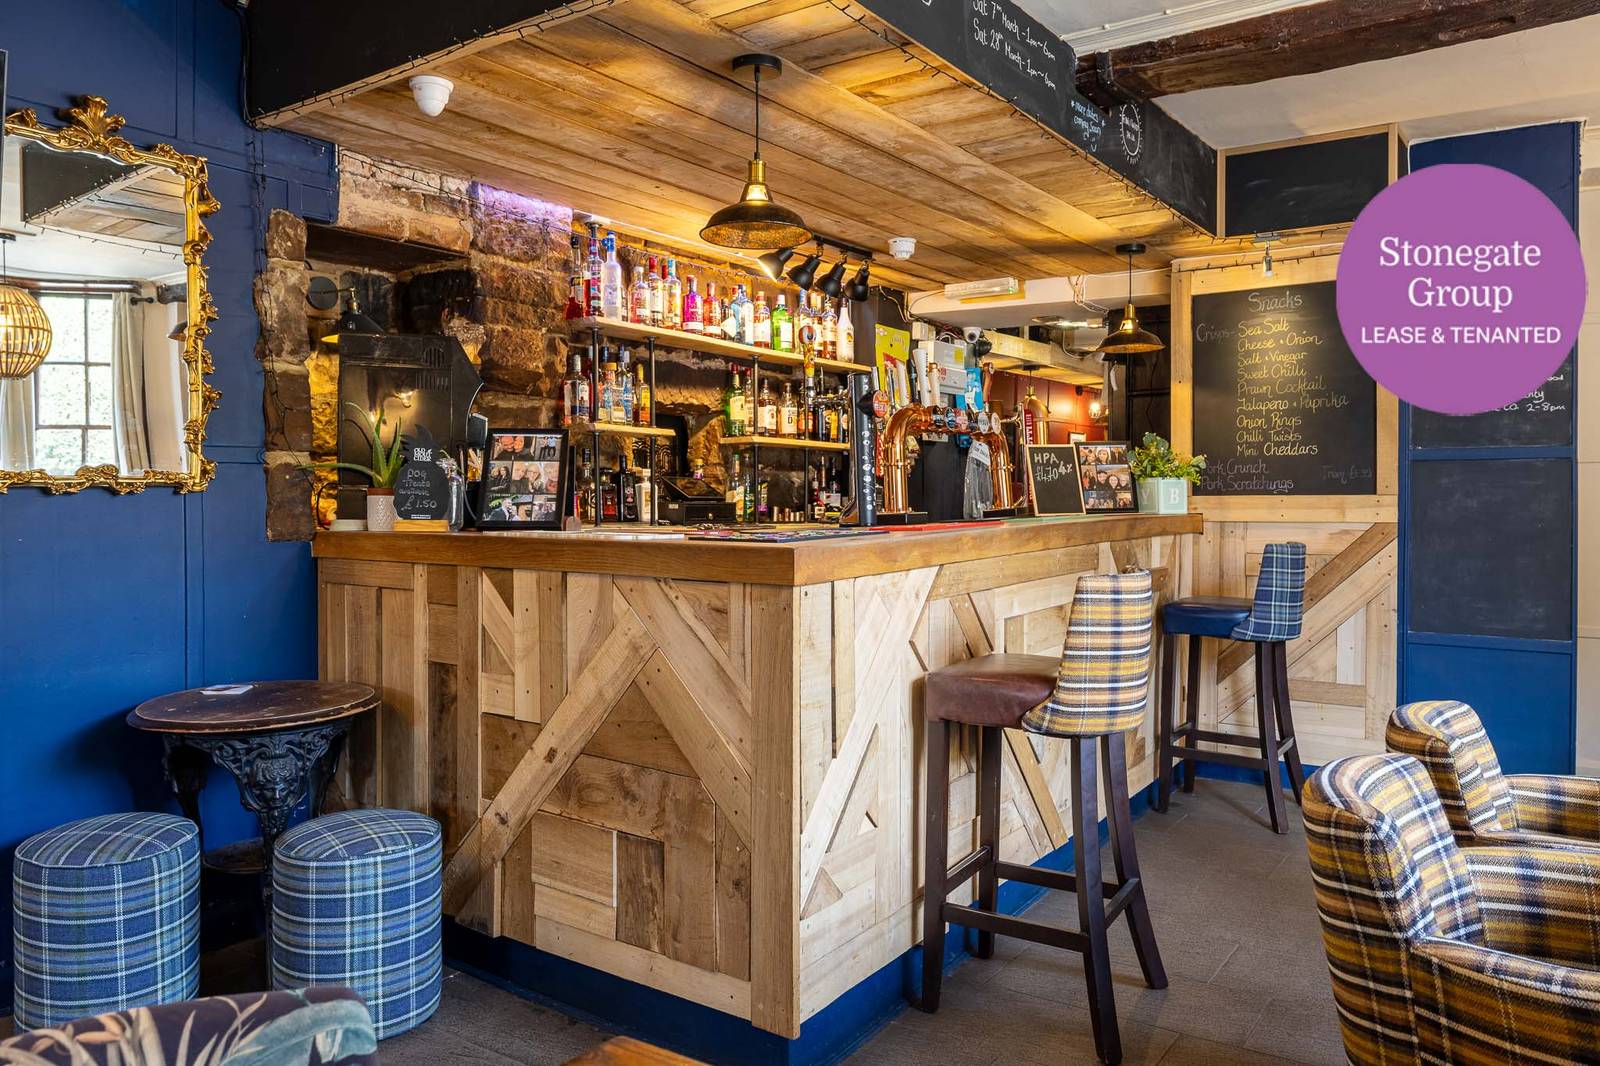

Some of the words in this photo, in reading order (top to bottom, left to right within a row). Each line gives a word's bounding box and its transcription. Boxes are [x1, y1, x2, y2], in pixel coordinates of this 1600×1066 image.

[973, 18, 988, 46] Sat
[1248, 290, 1303, 312] Snacks
[1238, 320, 1262, 338] Sea
[1263, 317, 1289, 335] Salt
[1237, 338, 1276, 352] Cheese
[1286, 331, 1323, 346] Onion
[1237, 352, 1262, 368] Salt
[1269, 351, 1308, 367] Vinegar
[1237, 365, 1269, 381] Sweet
[1271, 363, 1307, 378] Chilli
[1237, 382, 1273, 398] Prawn
[1276, 375, 1326, 396] Cocktail
[1300, 390, 1349, 413] Paprika
[1236, 414, 1267, 429] Onion
[1271, 411, 1302, 431] Rings
[1236, 430, 1264, 442] Chilli
[1269, 429, 1302, 442] Twists
[1034, 452, 1059, 465] HPA
[1237, 443, 1260, 457] Mini
[1263, 442, 1318, 456] Cheddars
[1227, 458, 1269, 474] Crunch
[1200, 475, 1226, 492] Pork
[400, 495, 438, 511] £1.50
[1168, 487, 1181, 506] B
